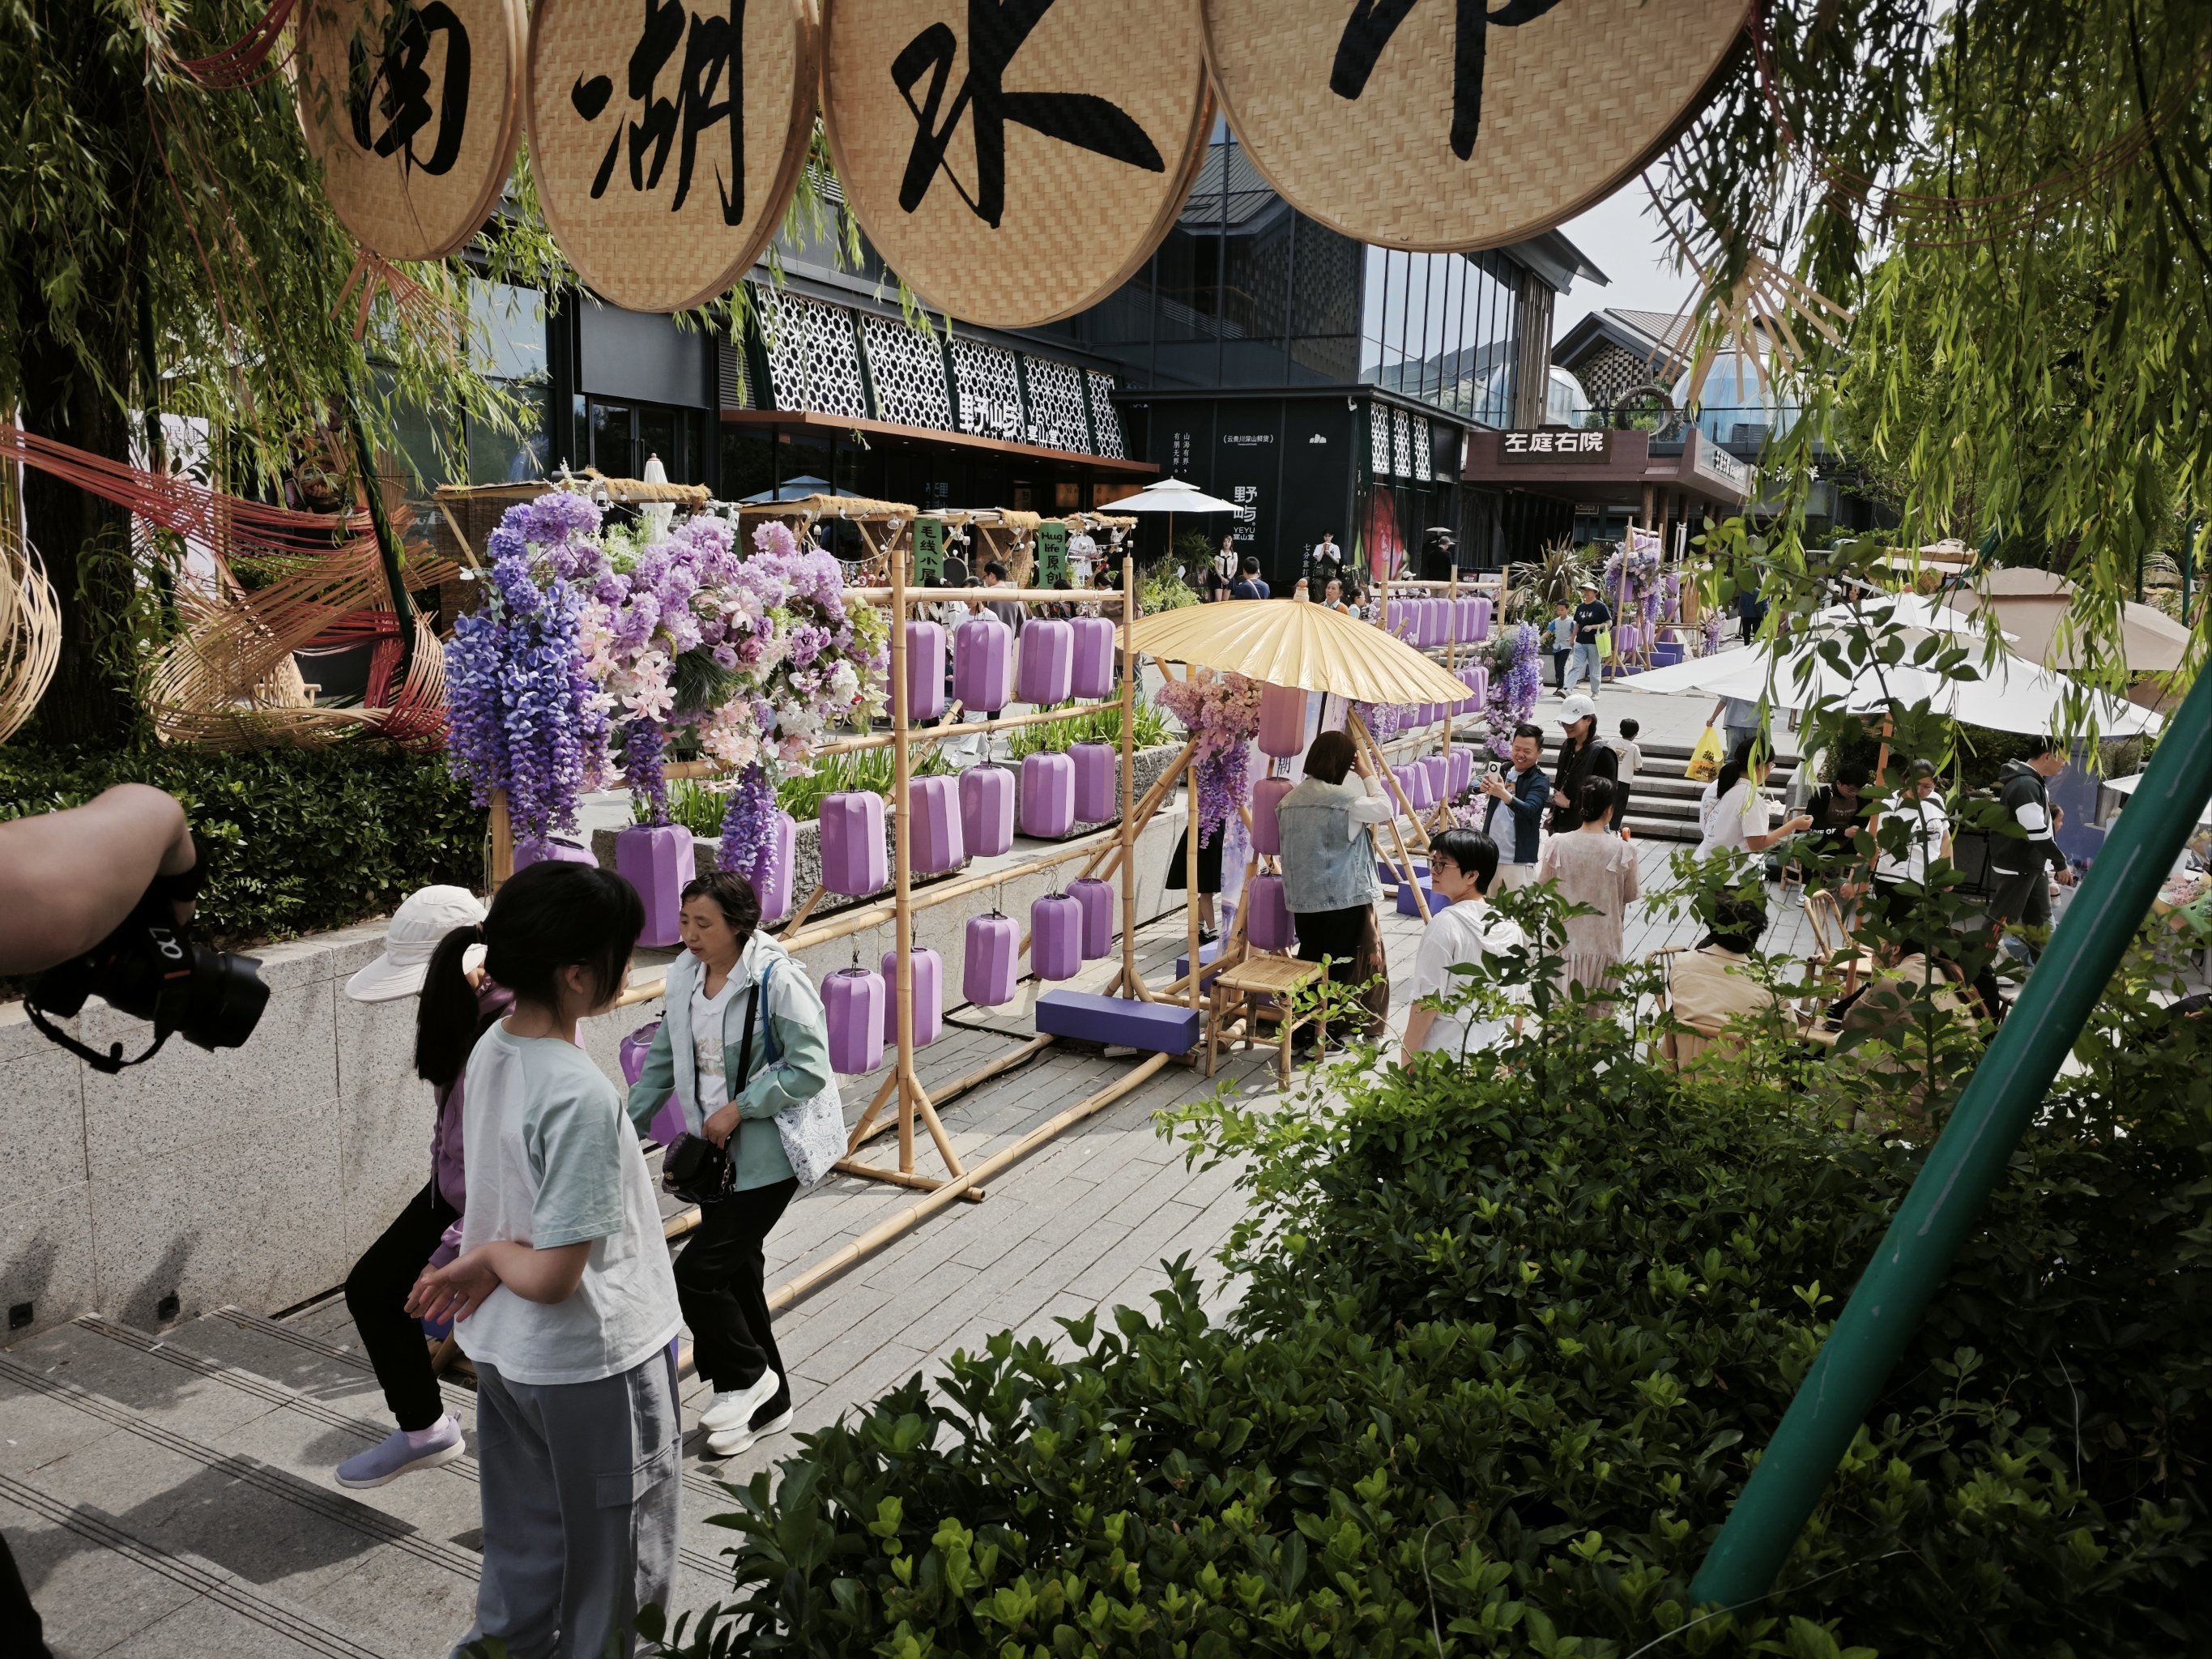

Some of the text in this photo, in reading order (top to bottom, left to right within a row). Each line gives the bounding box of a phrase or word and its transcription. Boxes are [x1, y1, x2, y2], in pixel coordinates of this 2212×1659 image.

[959, 393, 1018, 438] 野屿
[1027, 405, 1059, 426] YEYU
[1027, 424, 1058, 445] 宴山堂
[1504, 431, 1604, 453] 左庭右院
[1233, 486, 1258, 522] 野屿
[1041, 531, 1063, 543] Hug
[1044, 543, 1060, 552] life
[919, 526, 938, 582] 毛线小屋
[1045, 555, 1062, 585] 原创
